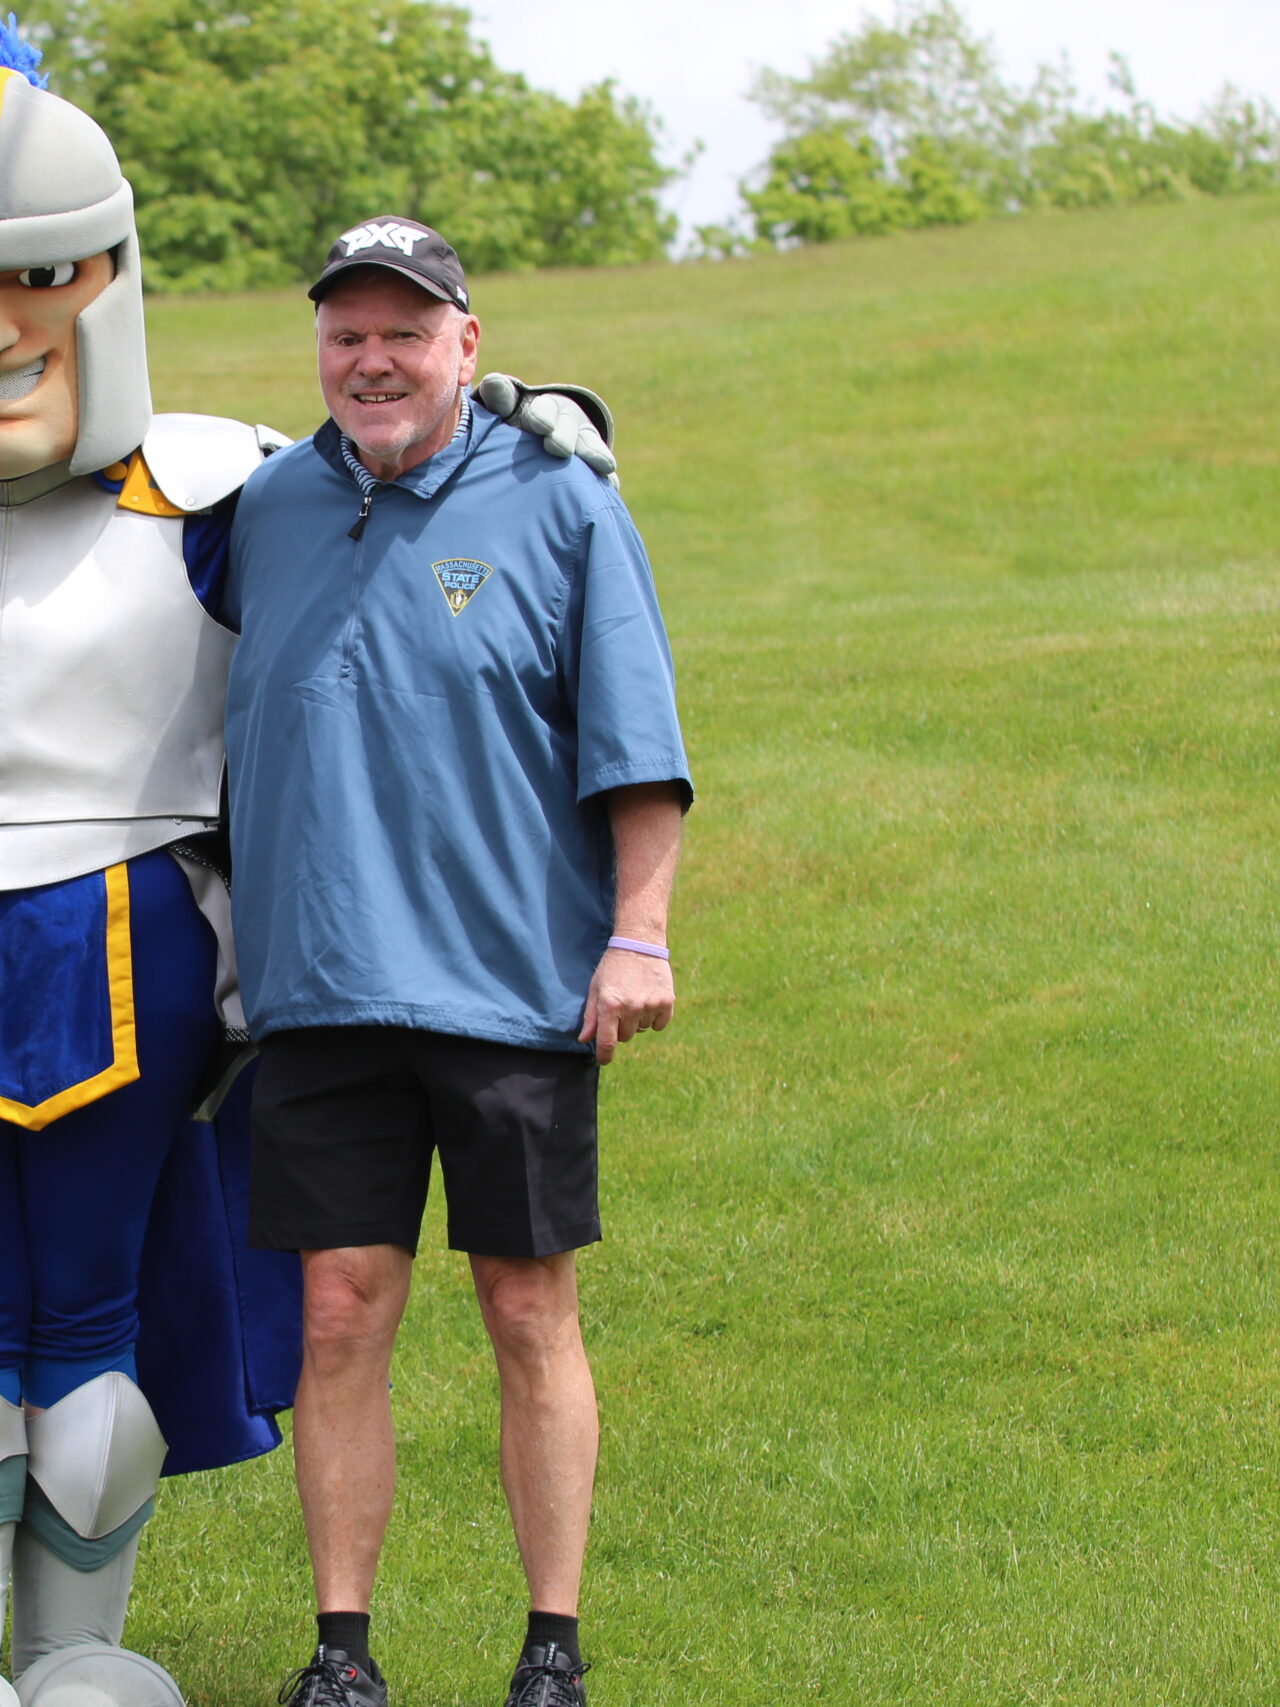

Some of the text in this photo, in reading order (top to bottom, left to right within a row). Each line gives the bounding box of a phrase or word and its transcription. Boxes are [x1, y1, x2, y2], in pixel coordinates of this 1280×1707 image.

[340, 222, 429, 257] PXG
[435, 560, 491, 576] MASSACHUSETTS
[441, 572, 480, 584] STATE
[444, 581, 476, 590] POLICE
